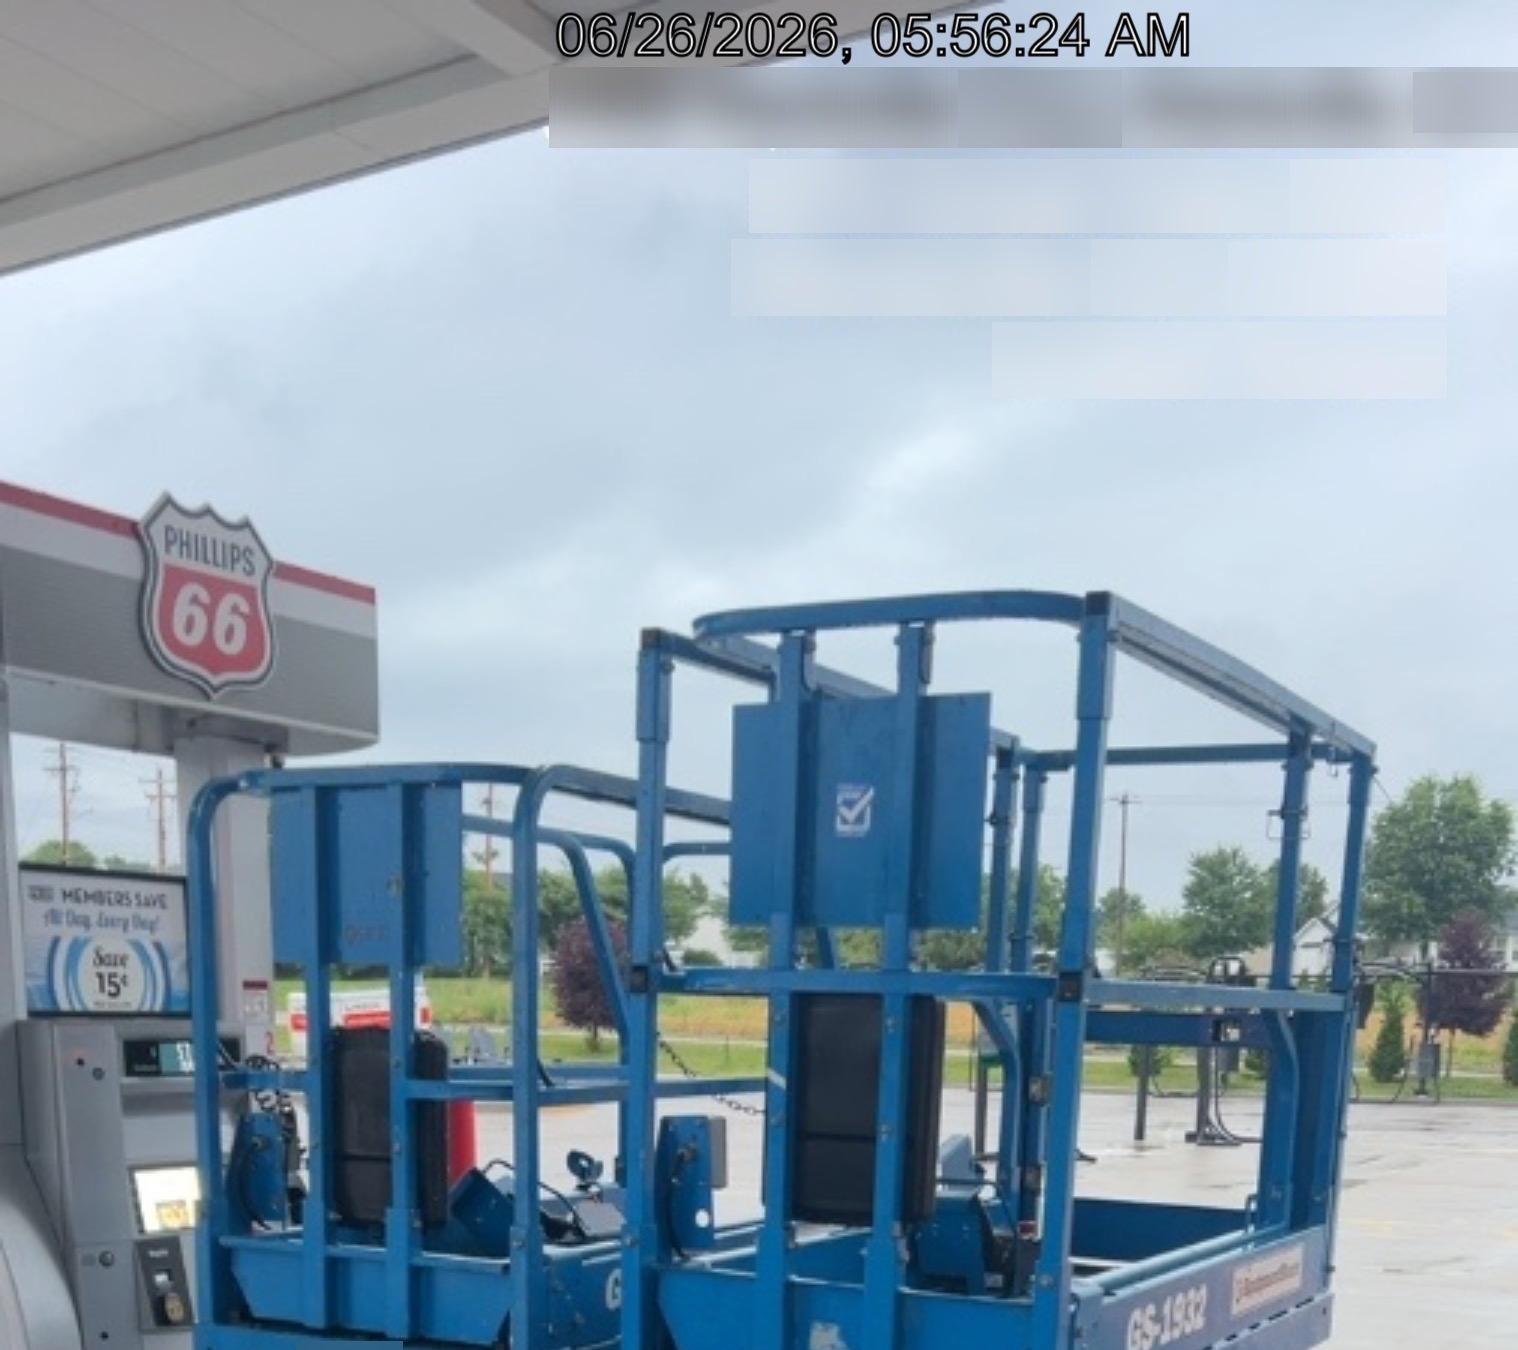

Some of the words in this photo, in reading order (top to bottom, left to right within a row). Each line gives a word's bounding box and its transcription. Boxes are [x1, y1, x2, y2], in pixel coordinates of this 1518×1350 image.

[164, 524, 256, 577] PHILLIPS
[172, 581, 251, 656] 66
[61, 887, 131, 907] MEMBERS
